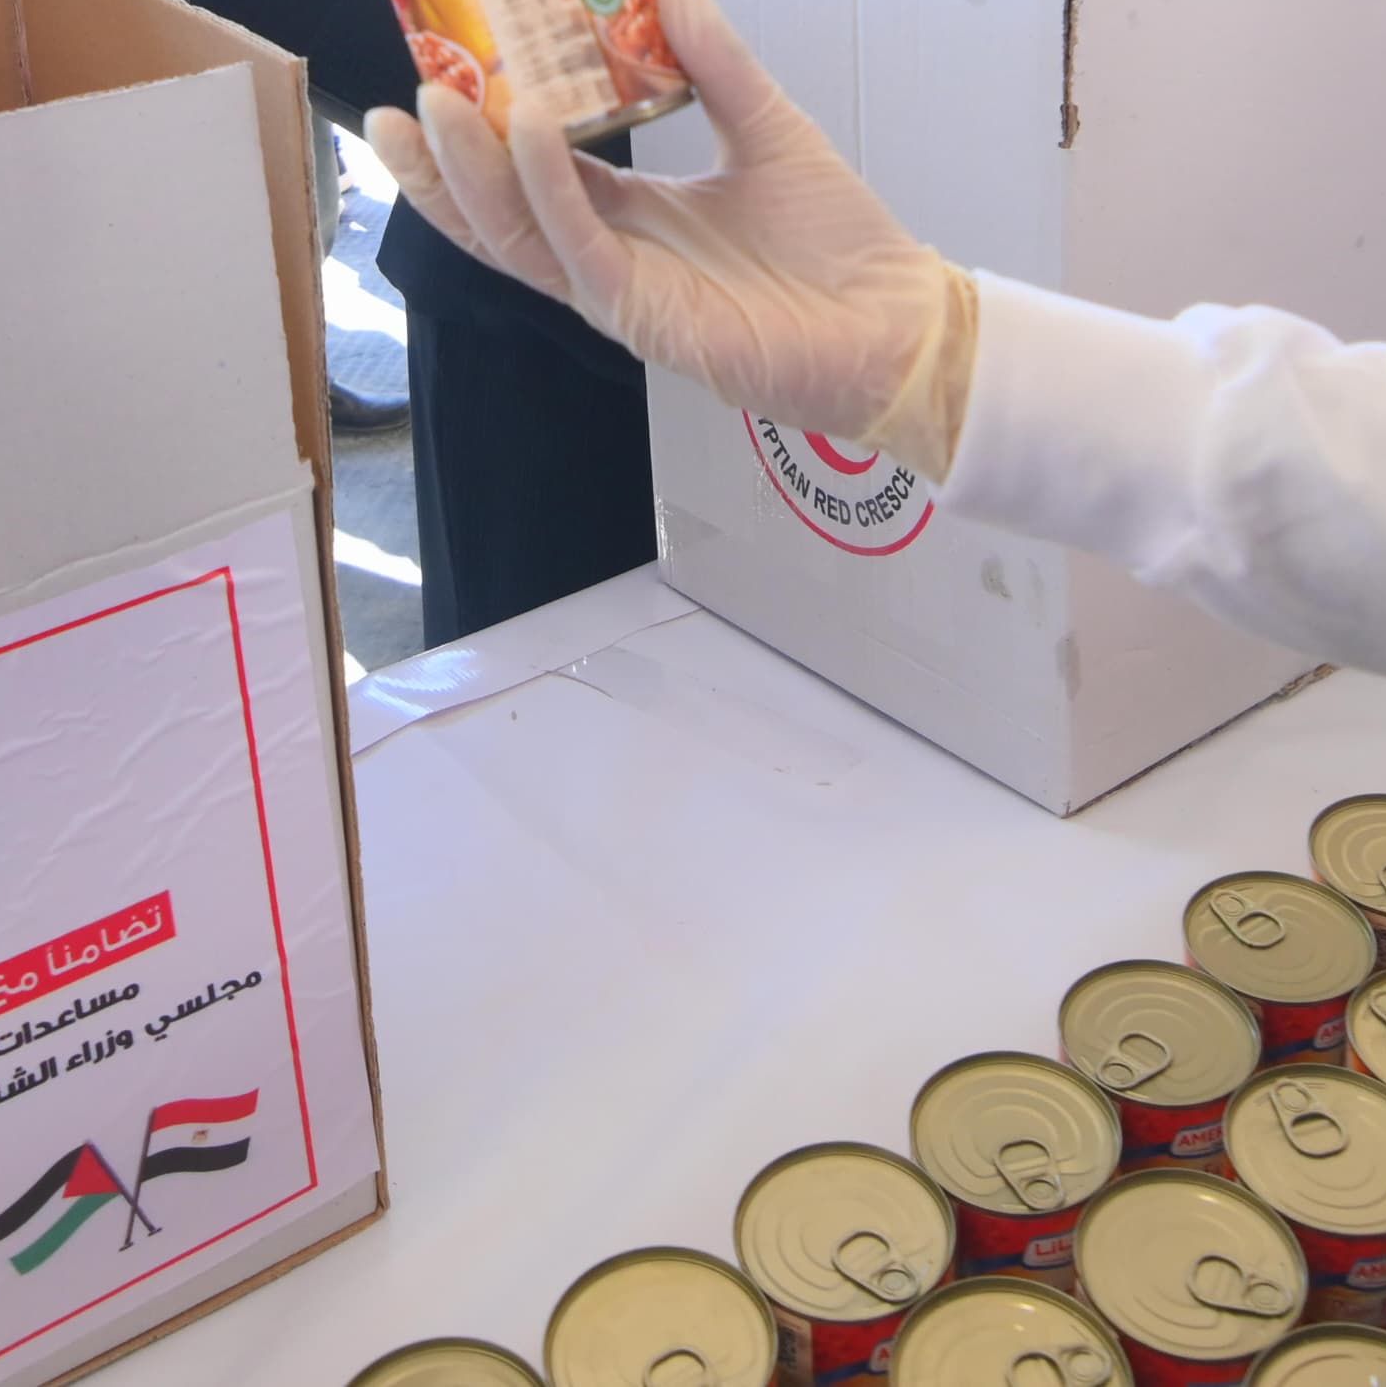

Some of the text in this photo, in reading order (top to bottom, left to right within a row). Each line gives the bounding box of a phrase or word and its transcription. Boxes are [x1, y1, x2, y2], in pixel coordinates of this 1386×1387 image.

[758, 417, 916, 527] YPTIAN RED CRESCE
[144, 970, 263, 1042] مجلسي
[65, 1029, 135, 1073] وزراء
